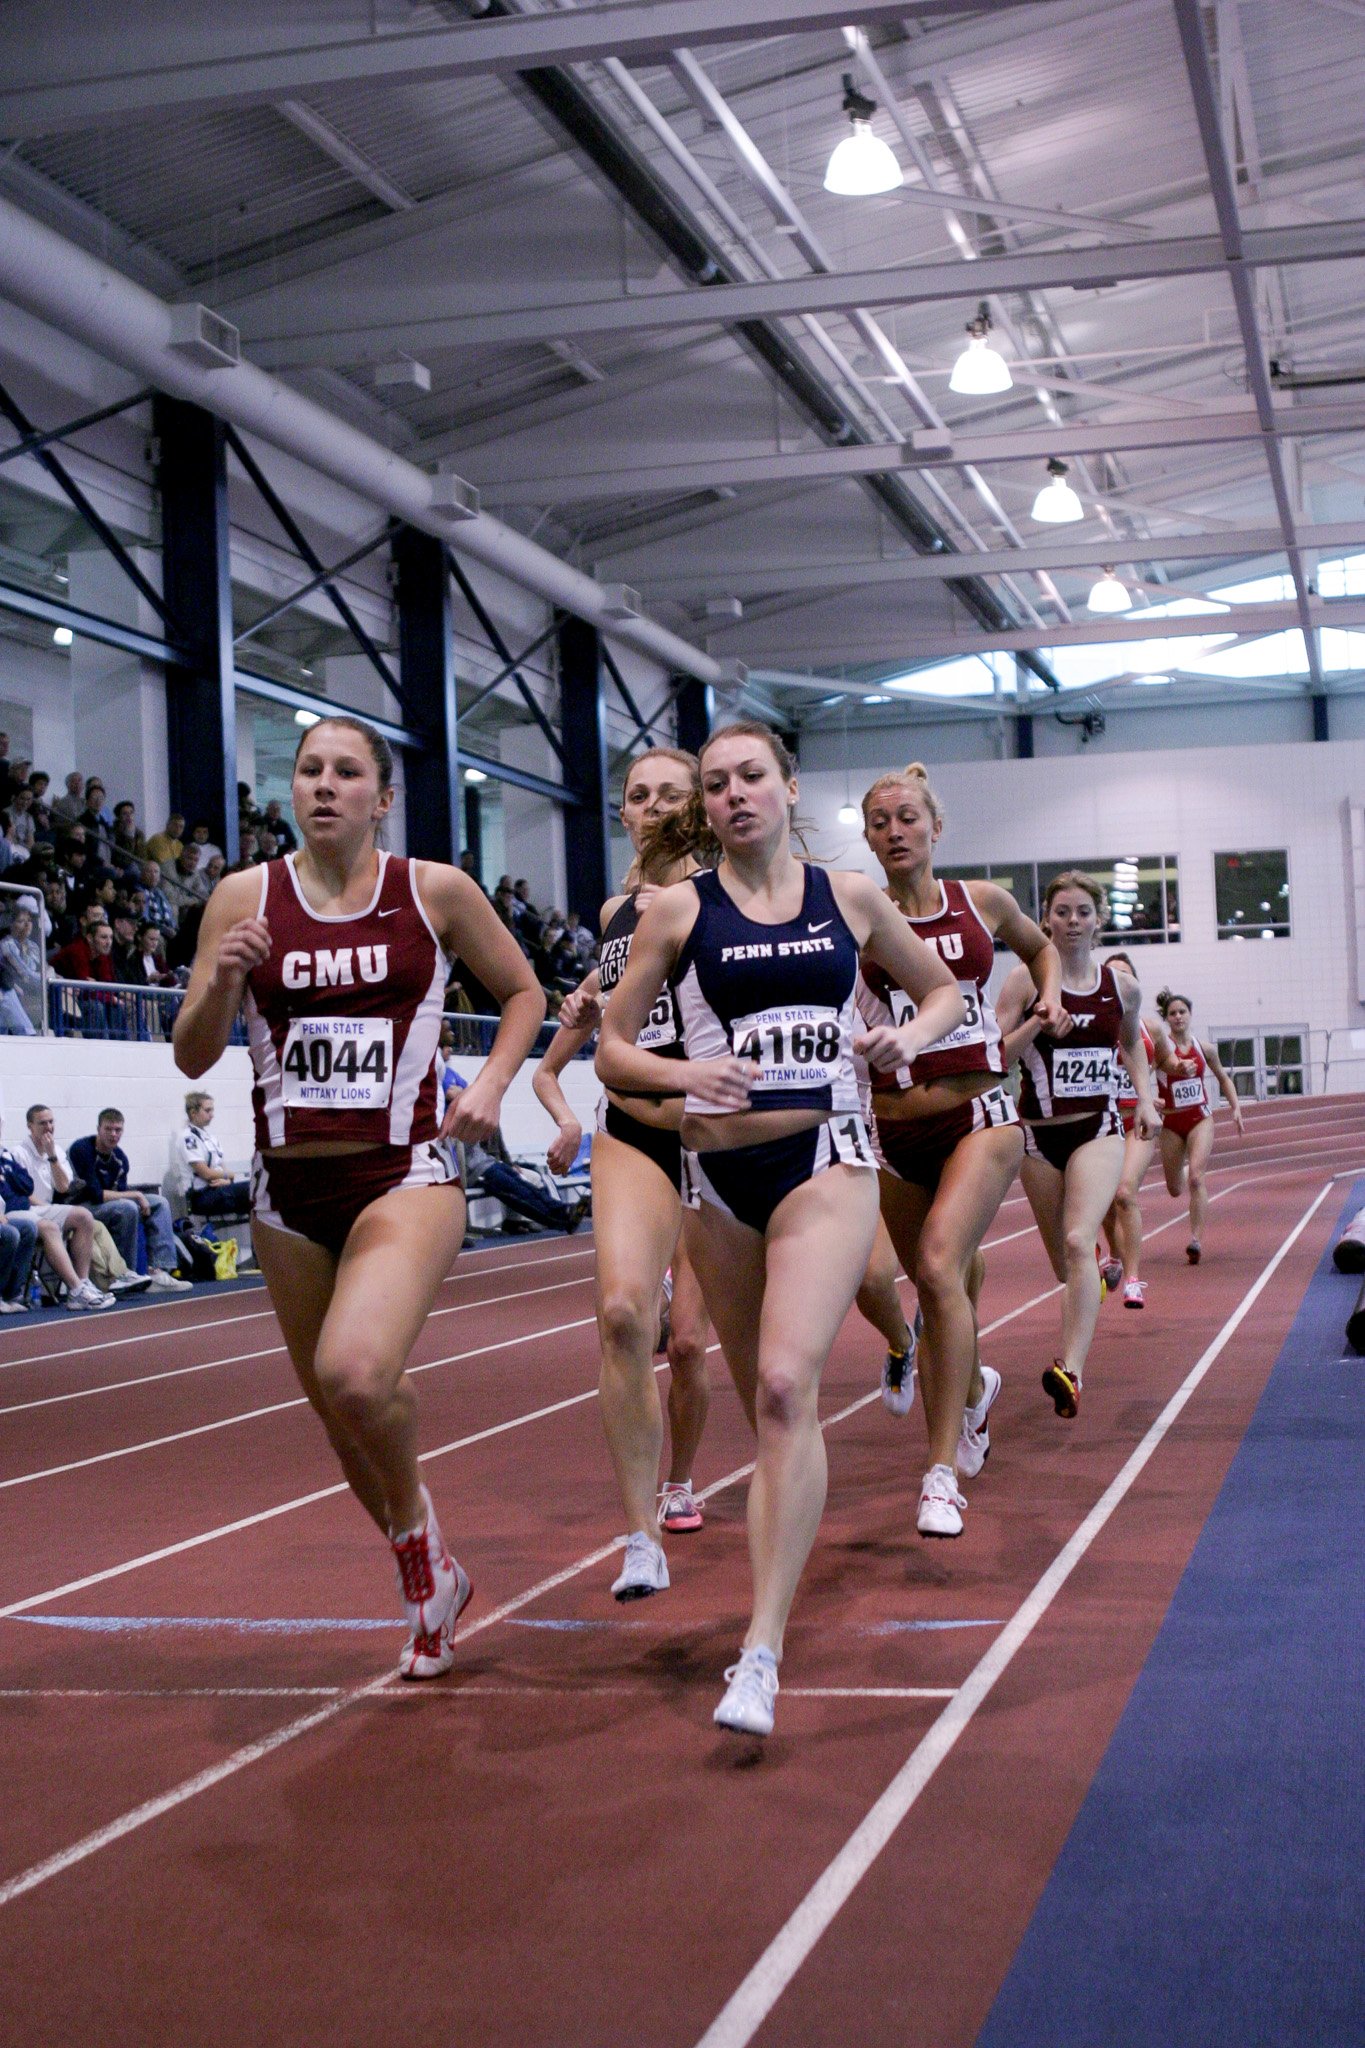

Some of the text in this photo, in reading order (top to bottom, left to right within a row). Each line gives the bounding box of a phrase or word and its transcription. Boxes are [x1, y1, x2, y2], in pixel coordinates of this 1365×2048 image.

[722, 937, 834, 962] PENN STATE
[282, 944, 389, 990] CMU
[756, 1010, 816, 1024] PENN STATE
[302, 1022, 365, 1034] PENN STATE
[640, 1030, 662, 1042] LIONS
[949, 1030, 971, 1041] LIONS
[737, 1021, 841, 1065] 4168
[284, 1039, 389, 1083] 4044
[800, 1067, 828, 1080] LIONS
[1055, 1059, 1111, 1084] 4244
[300, 1087, 371, 1099] NITTANY LIONS
[1174, 1084, 1202, 1099] 4307
